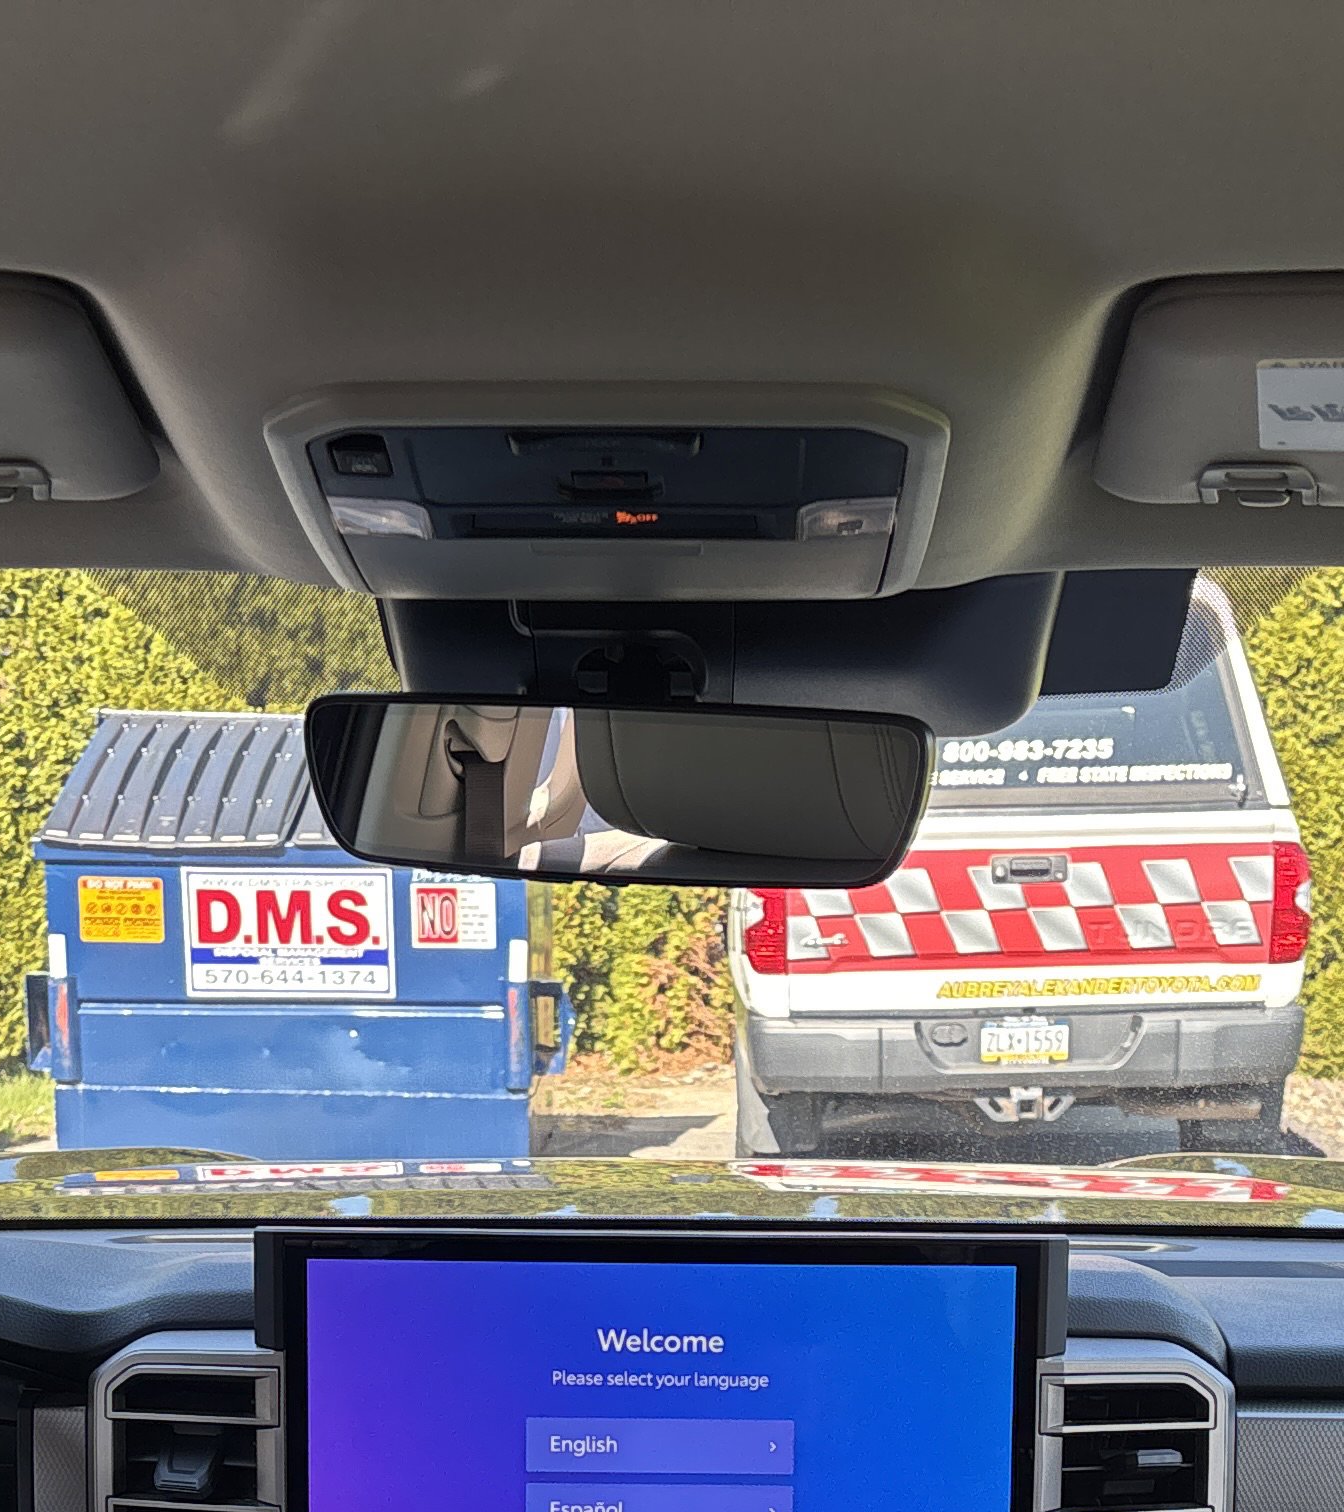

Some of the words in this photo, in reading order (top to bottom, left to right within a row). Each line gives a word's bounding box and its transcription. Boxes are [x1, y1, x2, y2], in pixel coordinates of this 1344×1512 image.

[196, 888, 381, 947] D.M.S.
[417, 892, 457, 939] NO
[205, 969, 376, 985] 570-644-1374
[596, 1327, 725, 1354] Welcome
[552, 1369, 604, 1387] Please
[606, 1371, 654, 1387] select
[655, 1372, 691, 1390] your
[693, 1371, 770, 1391] language
[549, 1434, 618, 1457] English
